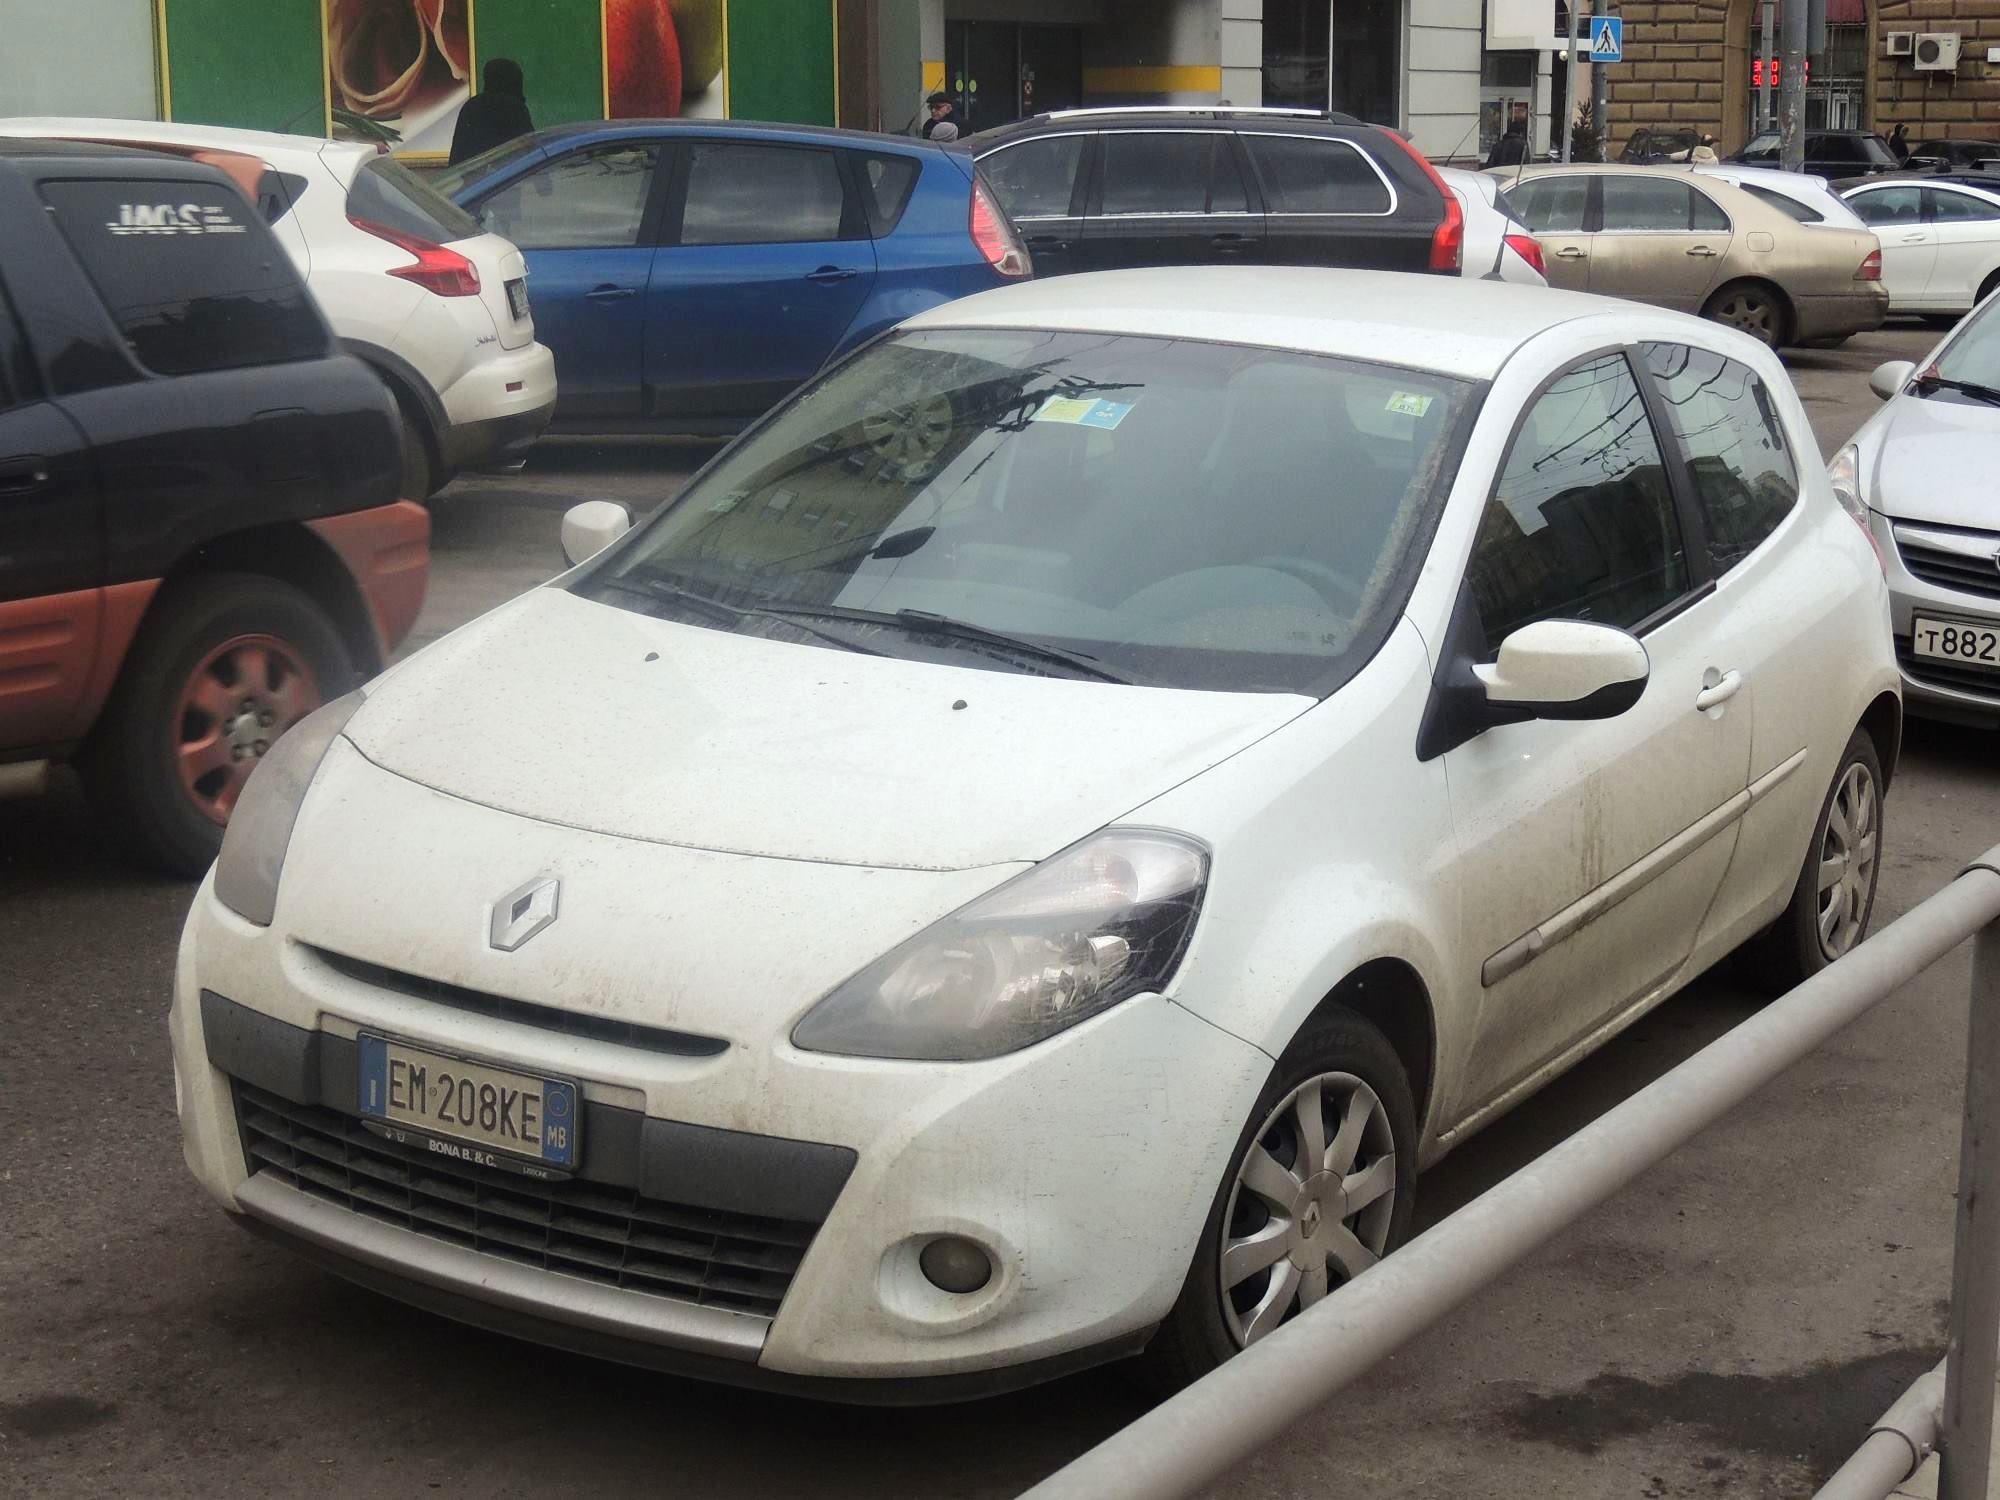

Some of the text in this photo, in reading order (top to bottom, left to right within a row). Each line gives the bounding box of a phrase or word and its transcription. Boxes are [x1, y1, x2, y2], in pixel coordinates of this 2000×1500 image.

[1925, 627, 2000, 661] T882
[547, 1125, 567, 1149] MB
[428, 1139, 460, 1158] BONA
[474, 1151, 484, 1165] &
